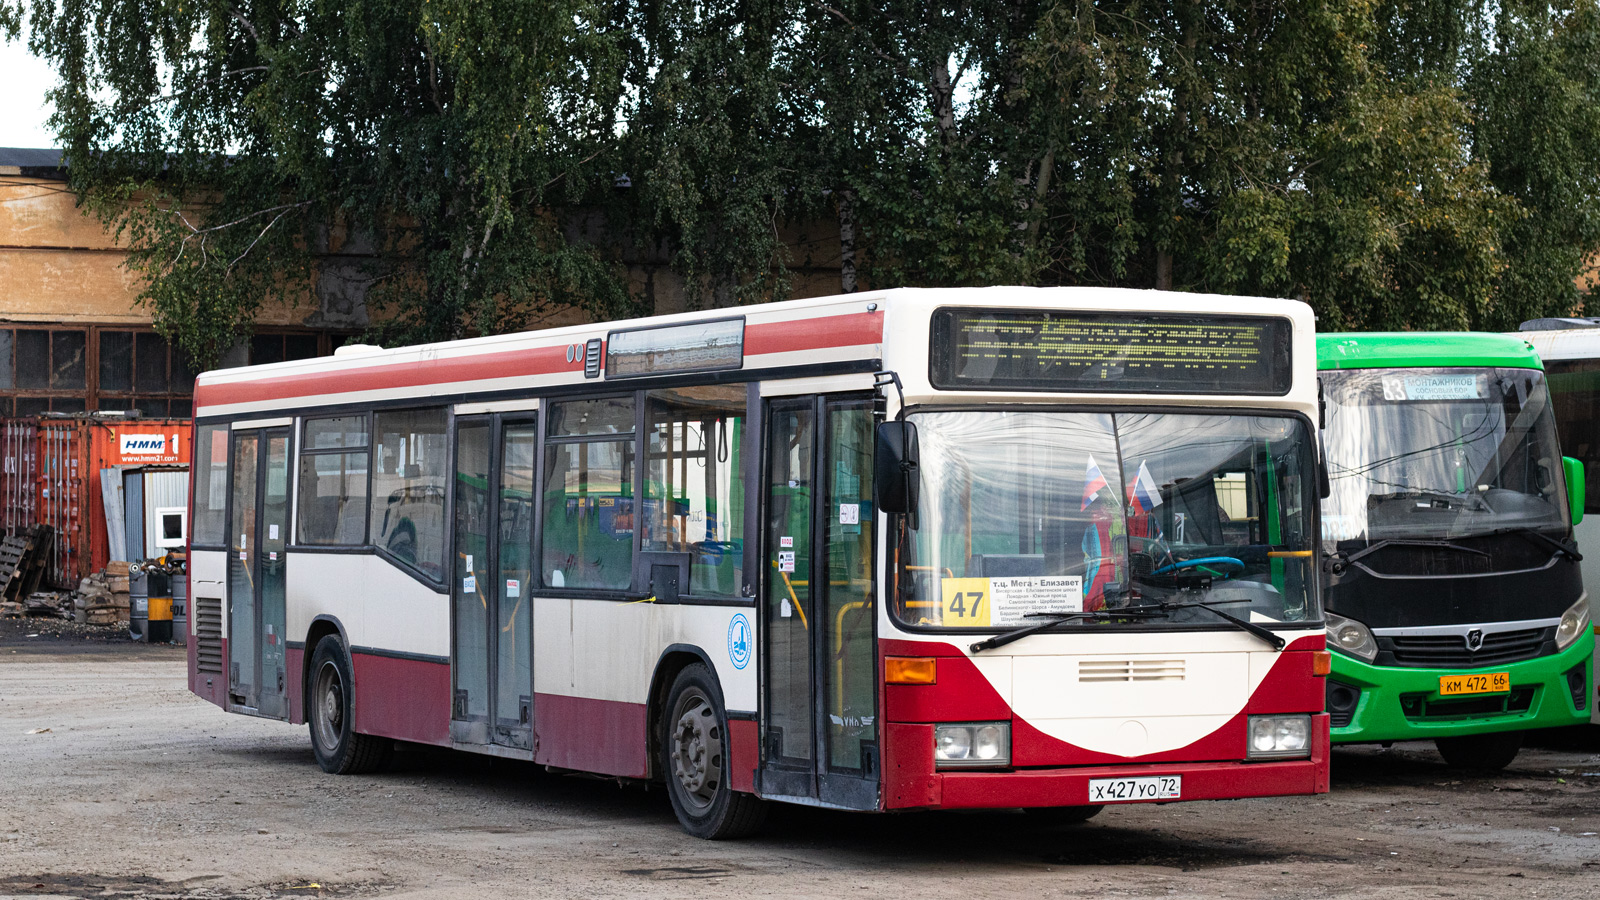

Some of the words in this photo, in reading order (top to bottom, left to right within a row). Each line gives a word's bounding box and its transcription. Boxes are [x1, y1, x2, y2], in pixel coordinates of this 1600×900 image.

[1408, 377, 1473, 387] МОНТАЖНИКОВ
[125, 440, 163, 449] HMM
[1010, 579, 1032, 587] Мега
[1040, 579, 1080, 587] Елизавет
[949, 591, 984, 618] 47
[1446, 681, 1462, 692] КМ
[1466, 676, 1487, 691] 472
[1493, 674, 1505, 686] 66
[1161, 778, 1176, 791] 72
